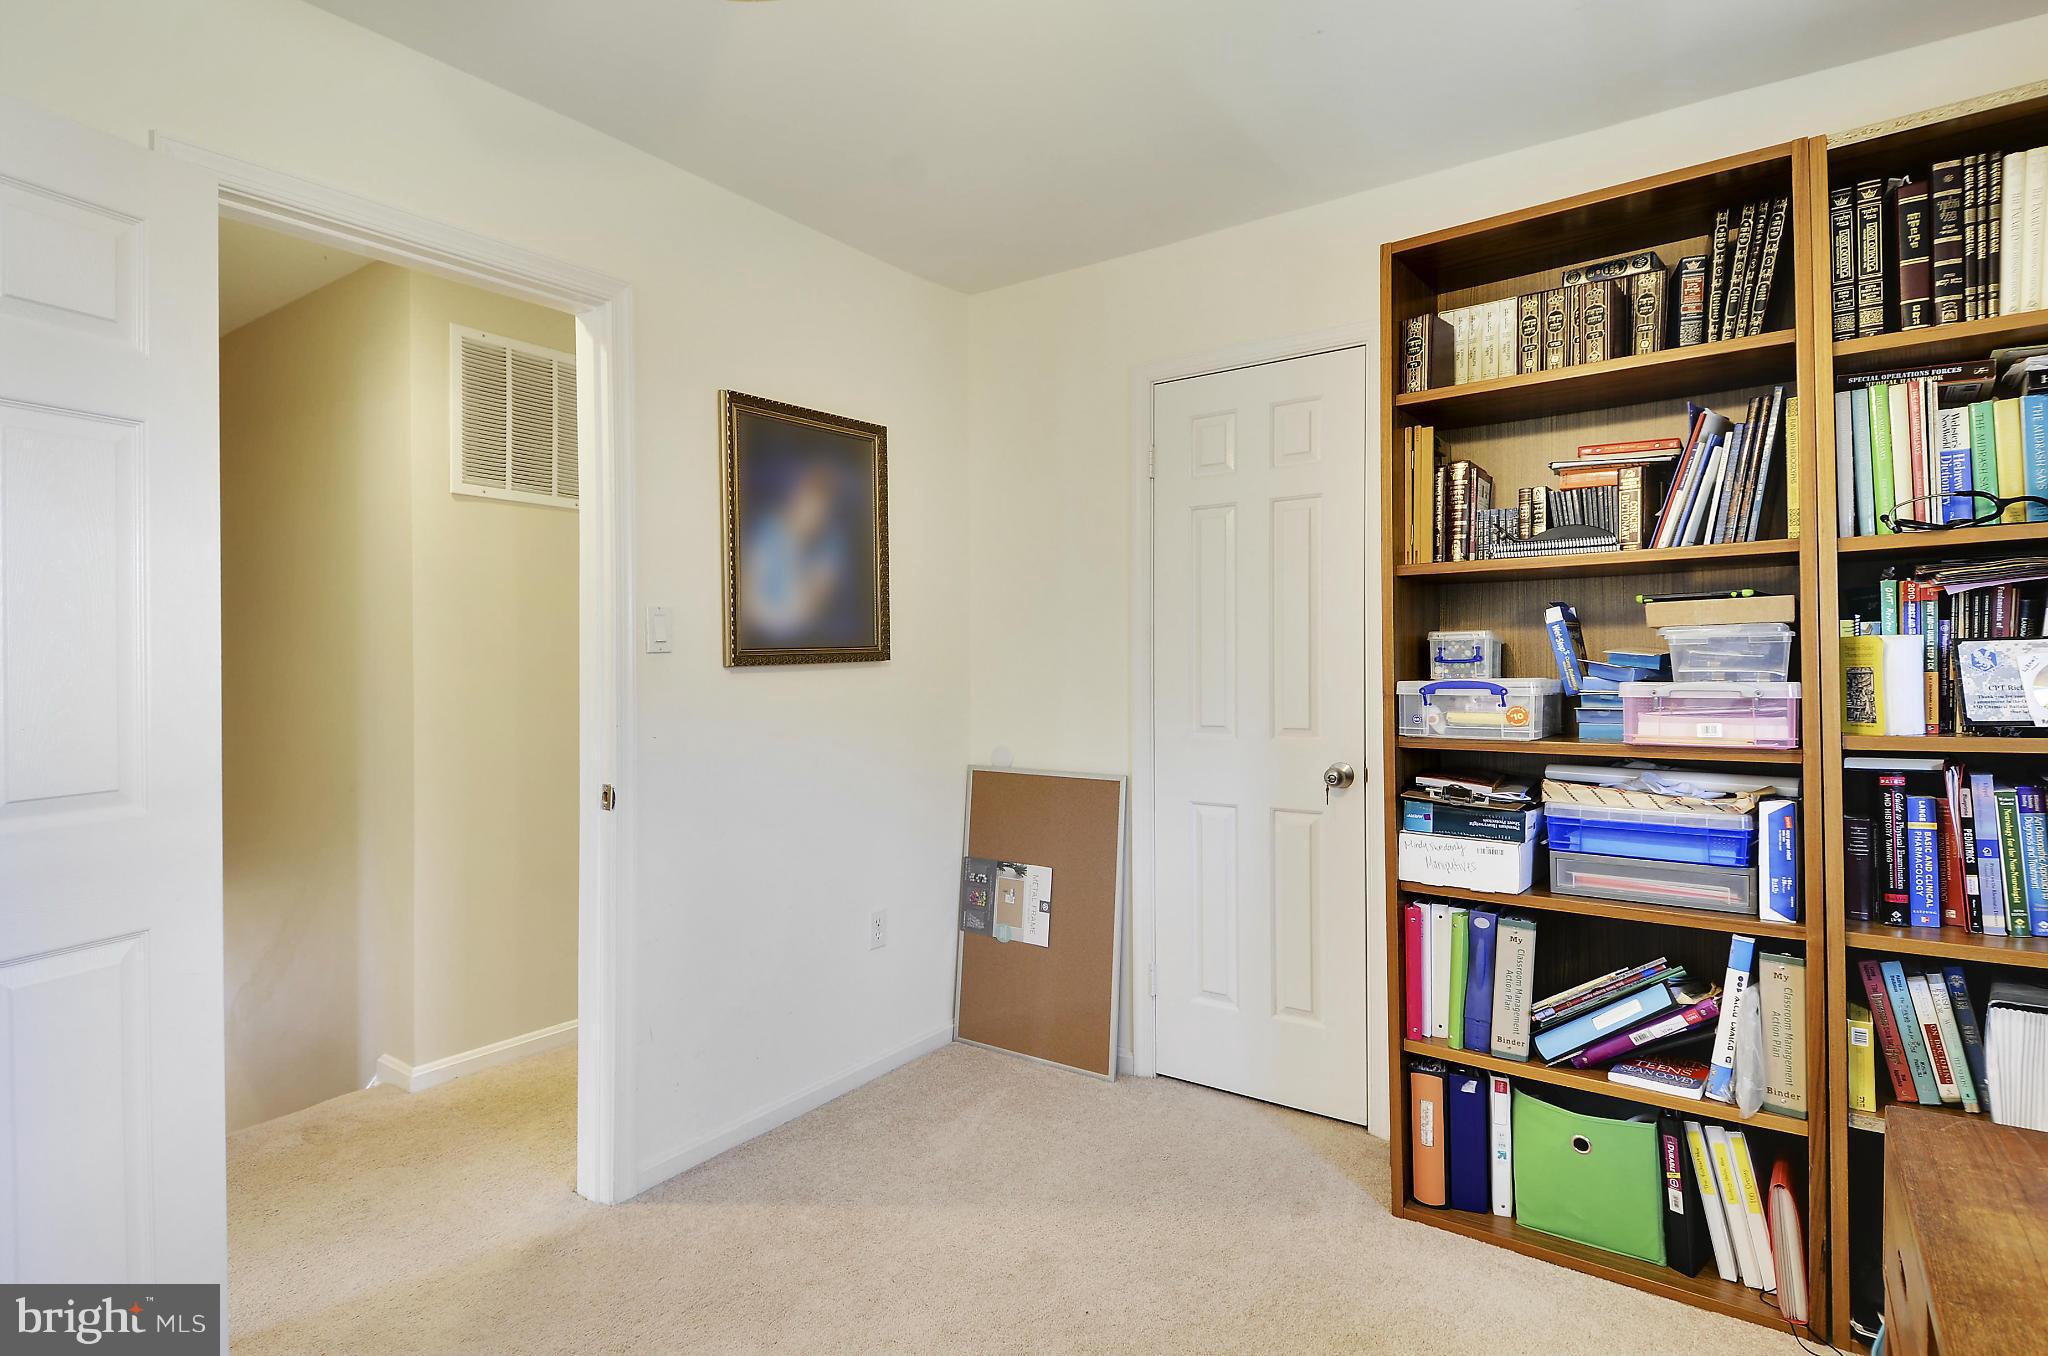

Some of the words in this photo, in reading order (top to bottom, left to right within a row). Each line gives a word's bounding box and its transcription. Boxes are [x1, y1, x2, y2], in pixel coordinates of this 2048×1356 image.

[1848, 375, 1880, 383] SPECIAL
[1881, 369, 1930, 380] OPERATIONS
[1931, 366, 1962, 376] FORCES
[1975, 412, 1985, 431] THE
[2031, 403, 2043, 423] THE
[1976, 432, 1988, 474] MIDRASH
[2033, 425, 2045, 466] MIDRASH
[1953, 454, 1965, 491] Hebrew
[2036, 468, 2047, 490] SAYS
[1620, 494, 1629, 540] DICTIONARY
[1629, 500, 1638, 533] CONCISE
[1907, 583, 1916, 599] 2010
[1927, 601, 1935, 616] FIRST
[1995, 586, 2005, 621] Fundamentals
[1885, 607, 1894, 632] Review
[1927, 646, 1935, 659] STEP
[1883, 793, 1892, 807] AND
[1895, 793, 1904, 812] Guide
[1918, 800, 1926, 822] LANGE
[1884, 808, 1893, 837] HISTORY
[2003, 808, 2014, 838] Neurology
[2024, 816, 2036, 846] Diagnosis
[2034, 816, 2044, 826] An
[1894, 821, 1905, 848] Physical
[1924, 831, 1933, 853] BASIC
[1964, 828, 1975, 864] PEDIATRICS
[2007, 837, 2016, 848] for
[2035, 827, 2046, 862] Osteopathic
[1885, 839, 1893, 863] TAKING
[2008, 848, 2017, 857] the
[2027, 846, 2037, 858] and
[1897, 849, 1906, 889] Examination
[1914, 831, 1924, 896] PHARMACOLOGY
[1925, 856, 1933, 871] AND
[2028, 859, 2040, 889] Treatment
[1031, 874, 1039, 900] METAL
[1925, 874, 1934, 908] CLINICAL
[2009, 858, 2020, 903] Non-Neurologist
[1029, 904, 1037, 935] FRAME
[1510, 936, 1523, 945] My
[1516, 948, 1525, 987] Classroom
[1773, 972, 1790, 982] My
[1505, 969, 1514, 992] Action
[1504, 992, 1512, 1011] Plan
[1512, 987, 1524, 1036] Management
[1784, 987, 1793, 1030] Classroom
[1772, 1010, 1781, 1032] Action
[1496, 1035, 1526, 1048] Binder
[1772, 1034, 1782, 1058] Plan
[1785, 1030, 1794, 1086] Management
[1930, 1024, 1938, 1034] ON
[1934, 1038, 1953, 1084] DOCTORING
[1621, 1065, 1654, 1075] SEAN
[1656, 1072, 1697, 1084] COVEY
[1636, 1060, 1693, 1076] TEENS
[1766, 1086, 1802, 1102] Binder
